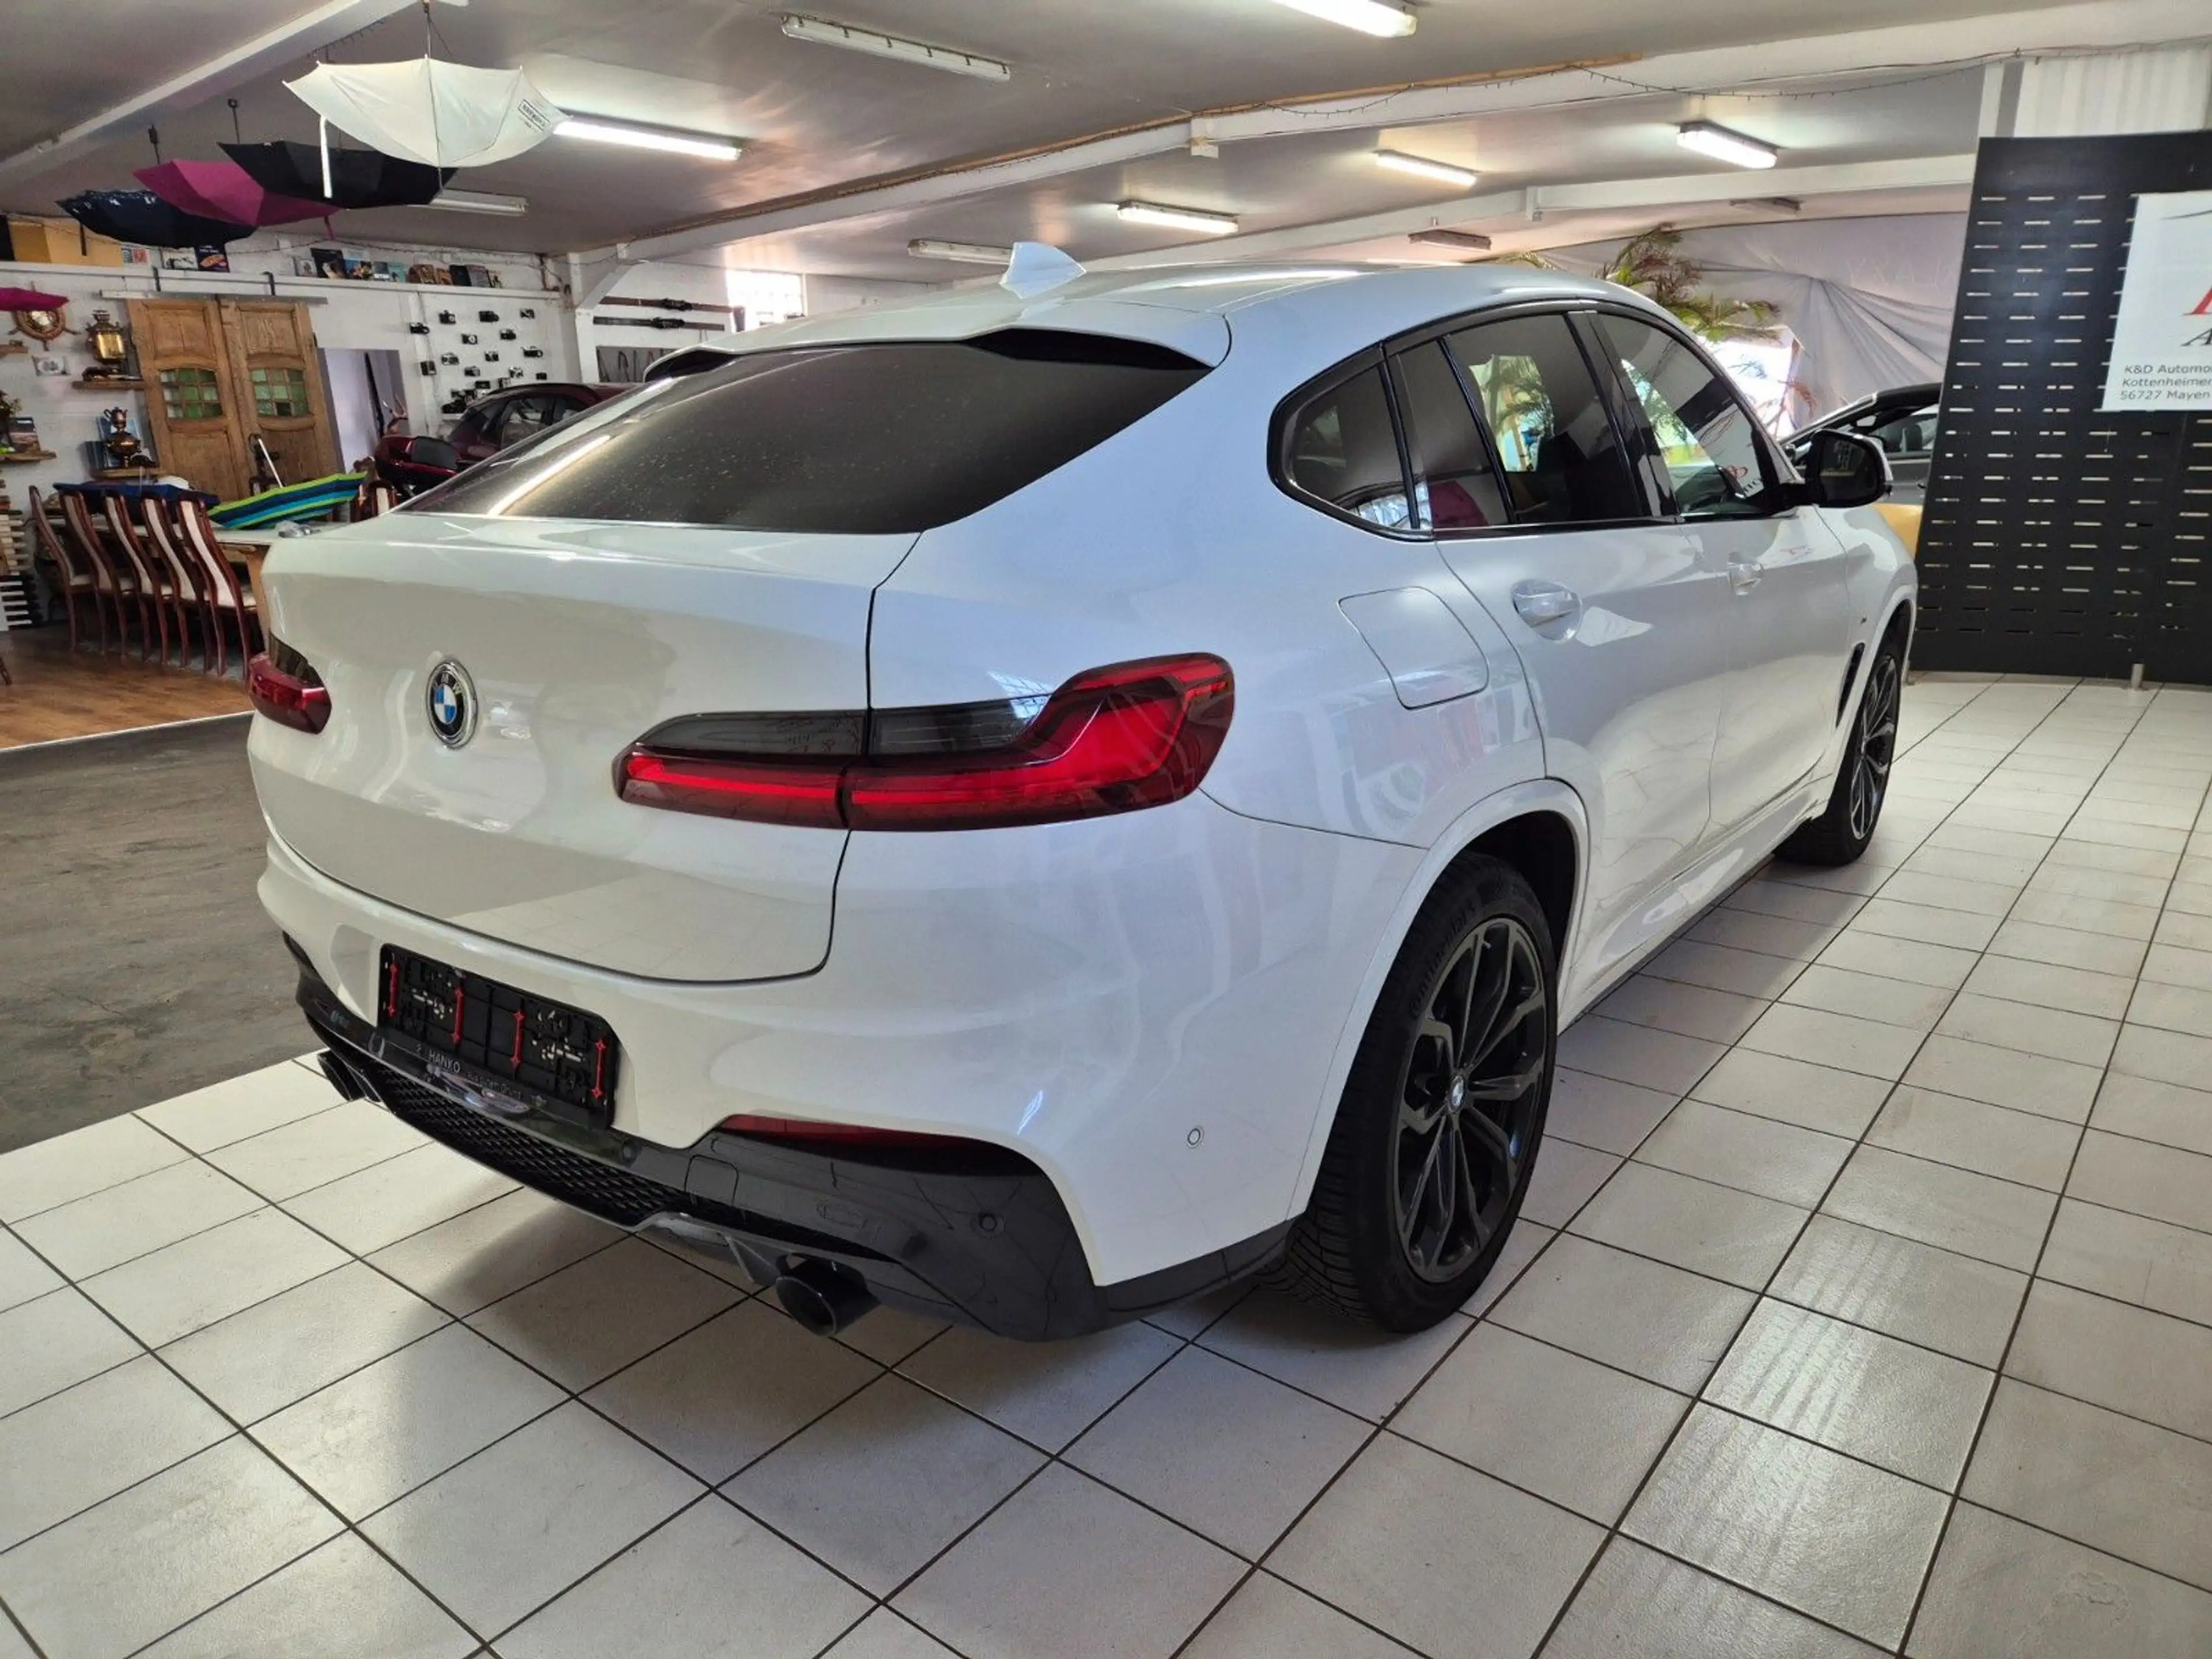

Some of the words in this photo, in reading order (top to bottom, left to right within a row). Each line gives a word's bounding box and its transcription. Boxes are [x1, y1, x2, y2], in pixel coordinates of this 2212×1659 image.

[2124, 365, 2153, 374] K&D
[2157, 365, 2212, 374] Automo
[2120, 390, 2161, 400] 56727
[2166, 390, 2210, 401] Mayen
